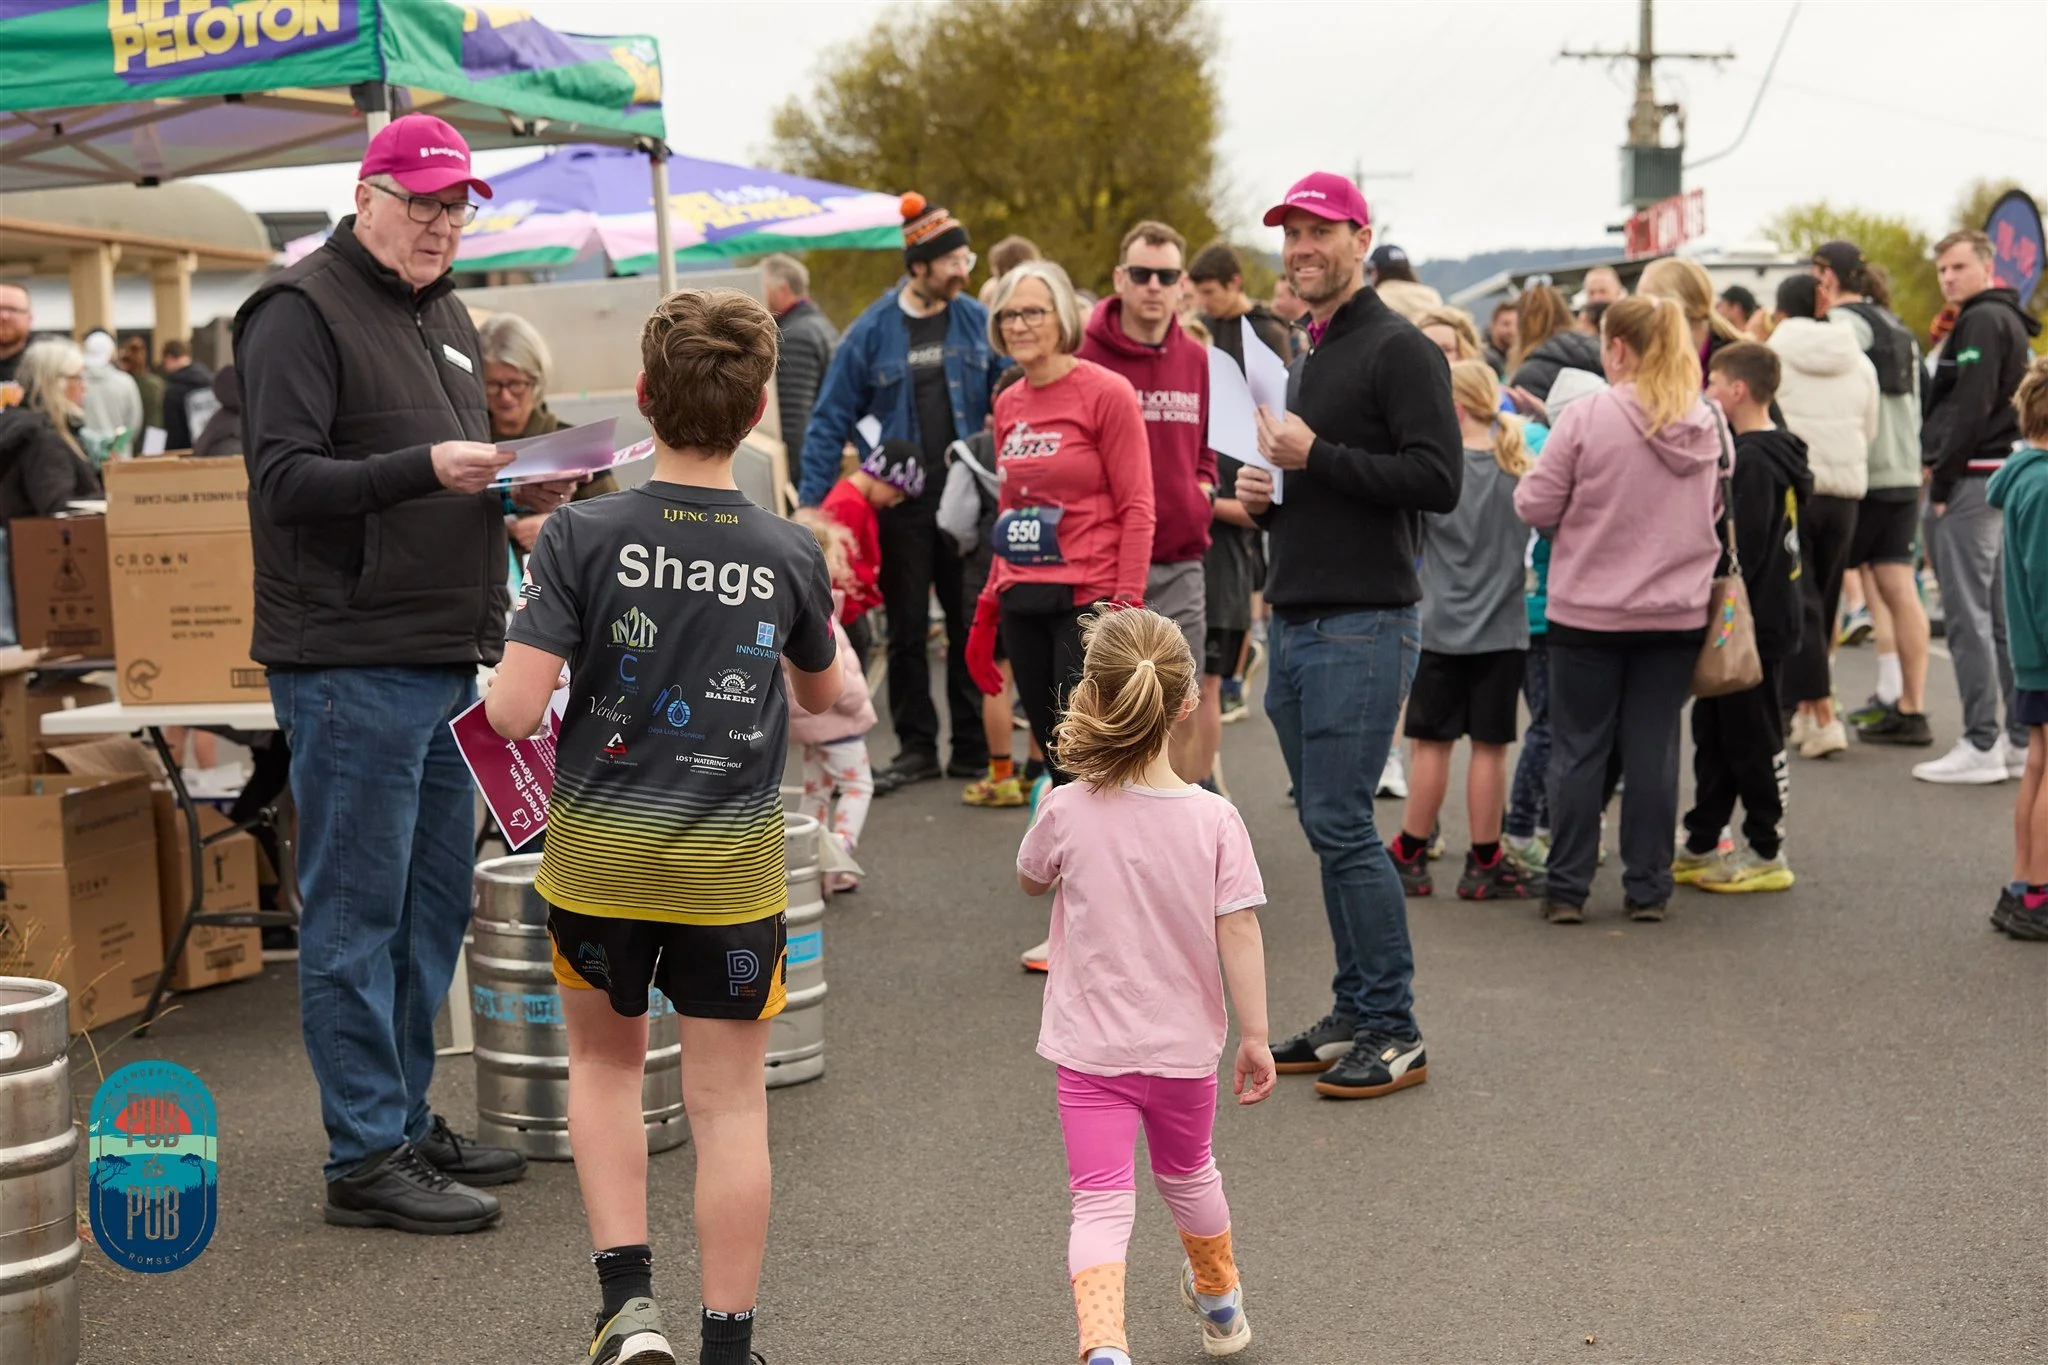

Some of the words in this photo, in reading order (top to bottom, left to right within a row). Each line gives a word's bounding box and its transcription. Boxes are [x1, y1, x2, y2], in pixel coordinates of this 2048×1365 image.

[110, 0, 340, 74] PELOTON
[664, 508, 708, 523] LJFNC
[714, 513, 739, 524] 2024
[1007, 519, 1041, 542] 550
[616, 543, 775, 606] Shags
[610, 605, 658, 649] IN2IT
[717, 667, 752, 681] Lancefield
[588, 694, 632, 725] Verdure
[704, 691, 757, 705] BAKERY
[505, 740, 534, 785] Reward.
[675, 755, 693, 763] LOST
[693, 757, 727, 768] WATERING
[727, 761, 743, 769] HOLE
[509, 764, 526, 791] Run,
[521, 790, 544, 822] Great
